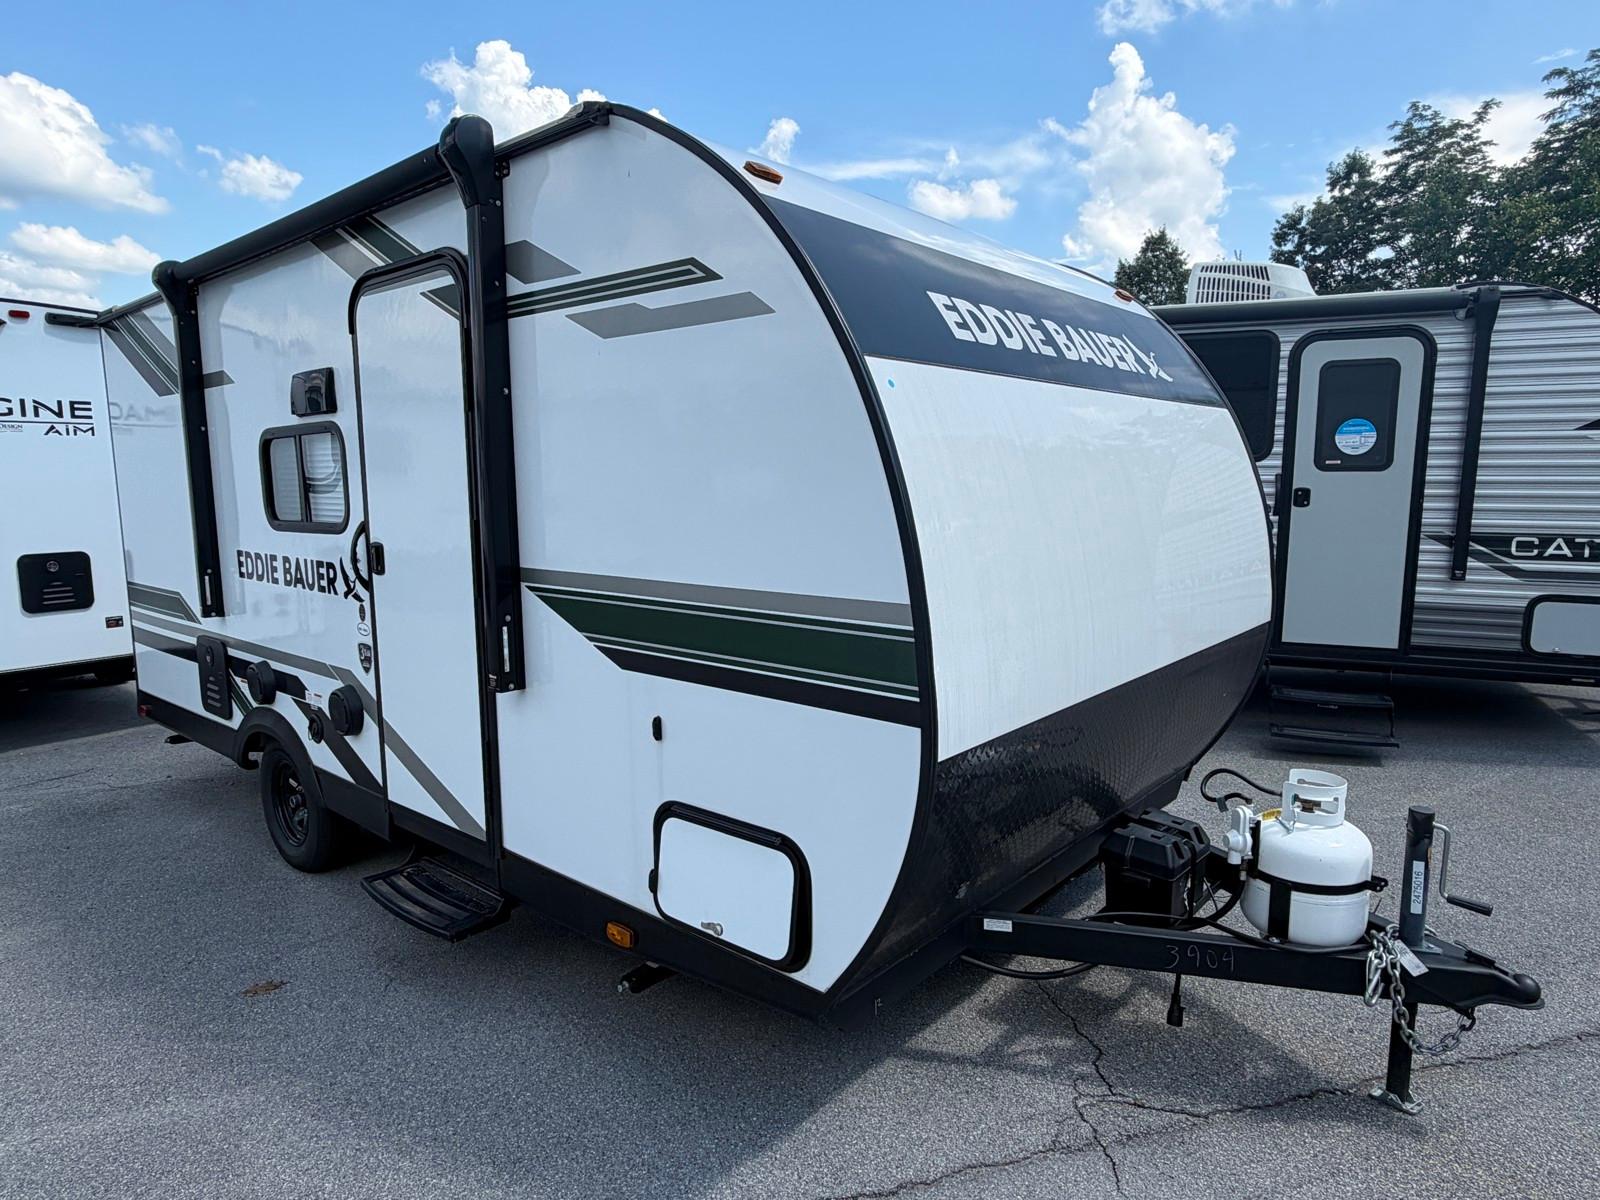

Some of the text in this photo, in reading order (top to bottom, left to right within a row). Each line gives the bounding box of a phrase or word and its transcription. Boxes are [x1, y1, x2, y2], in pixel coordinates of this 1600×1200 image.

[926, 290, 1146, 375] EDDIE BAUER
[1510, 536, 1600, 558] CAT
[236, 549, 338, 596] EDDIE BAUER
[1412, 870, 1423, 905] 2475016
[1164, 944, 1235, 973] 3904
